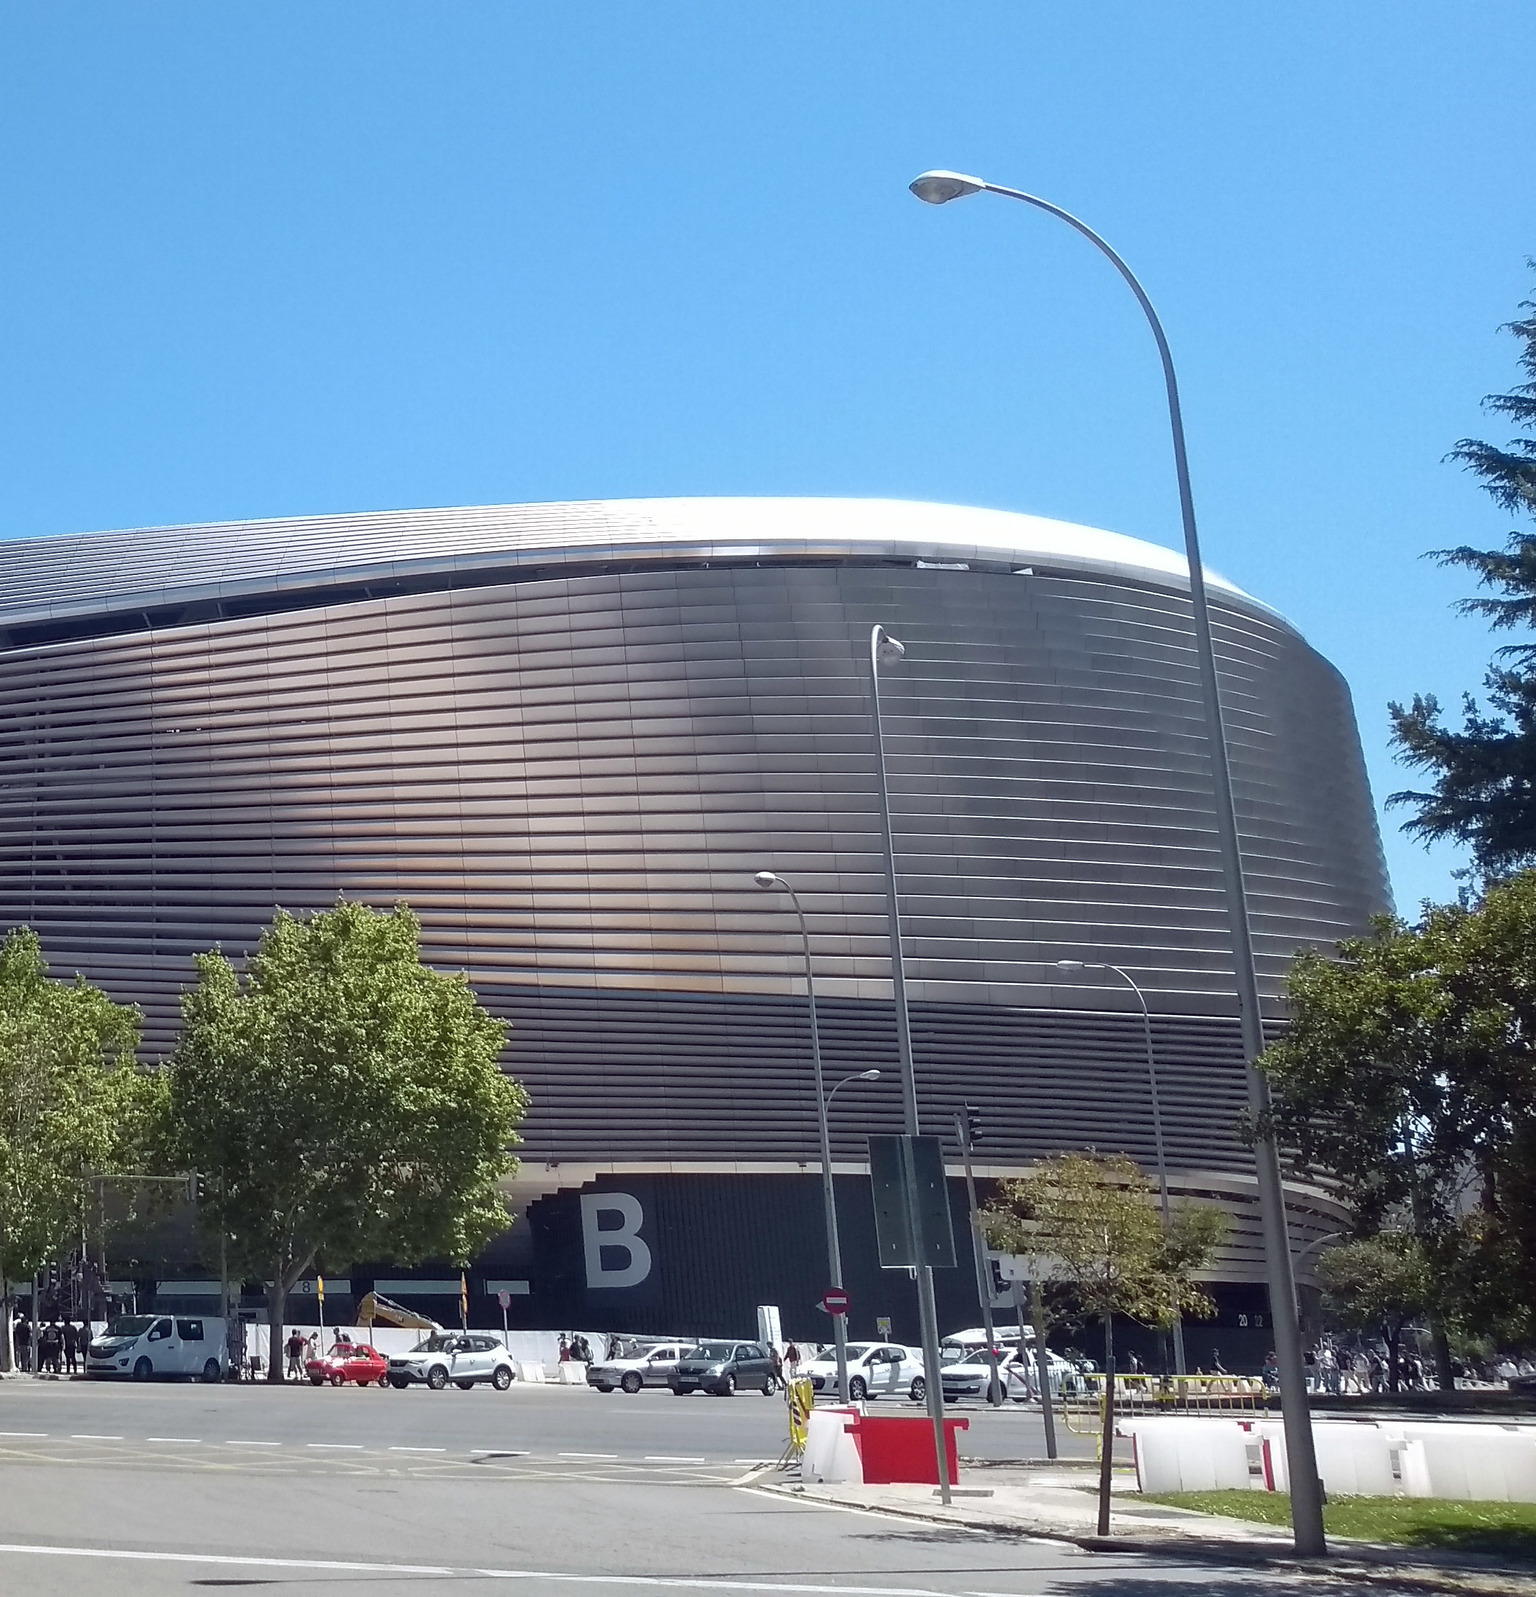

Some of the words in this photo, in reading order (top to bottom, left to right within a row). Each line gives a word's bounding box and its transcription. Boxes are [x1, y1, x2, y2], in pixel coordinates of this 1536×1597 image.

[580, 1192, 652, 1288] B
[303, 1281, 310, 1292] 8
[1238, 1314, 1248, 1326] 20
